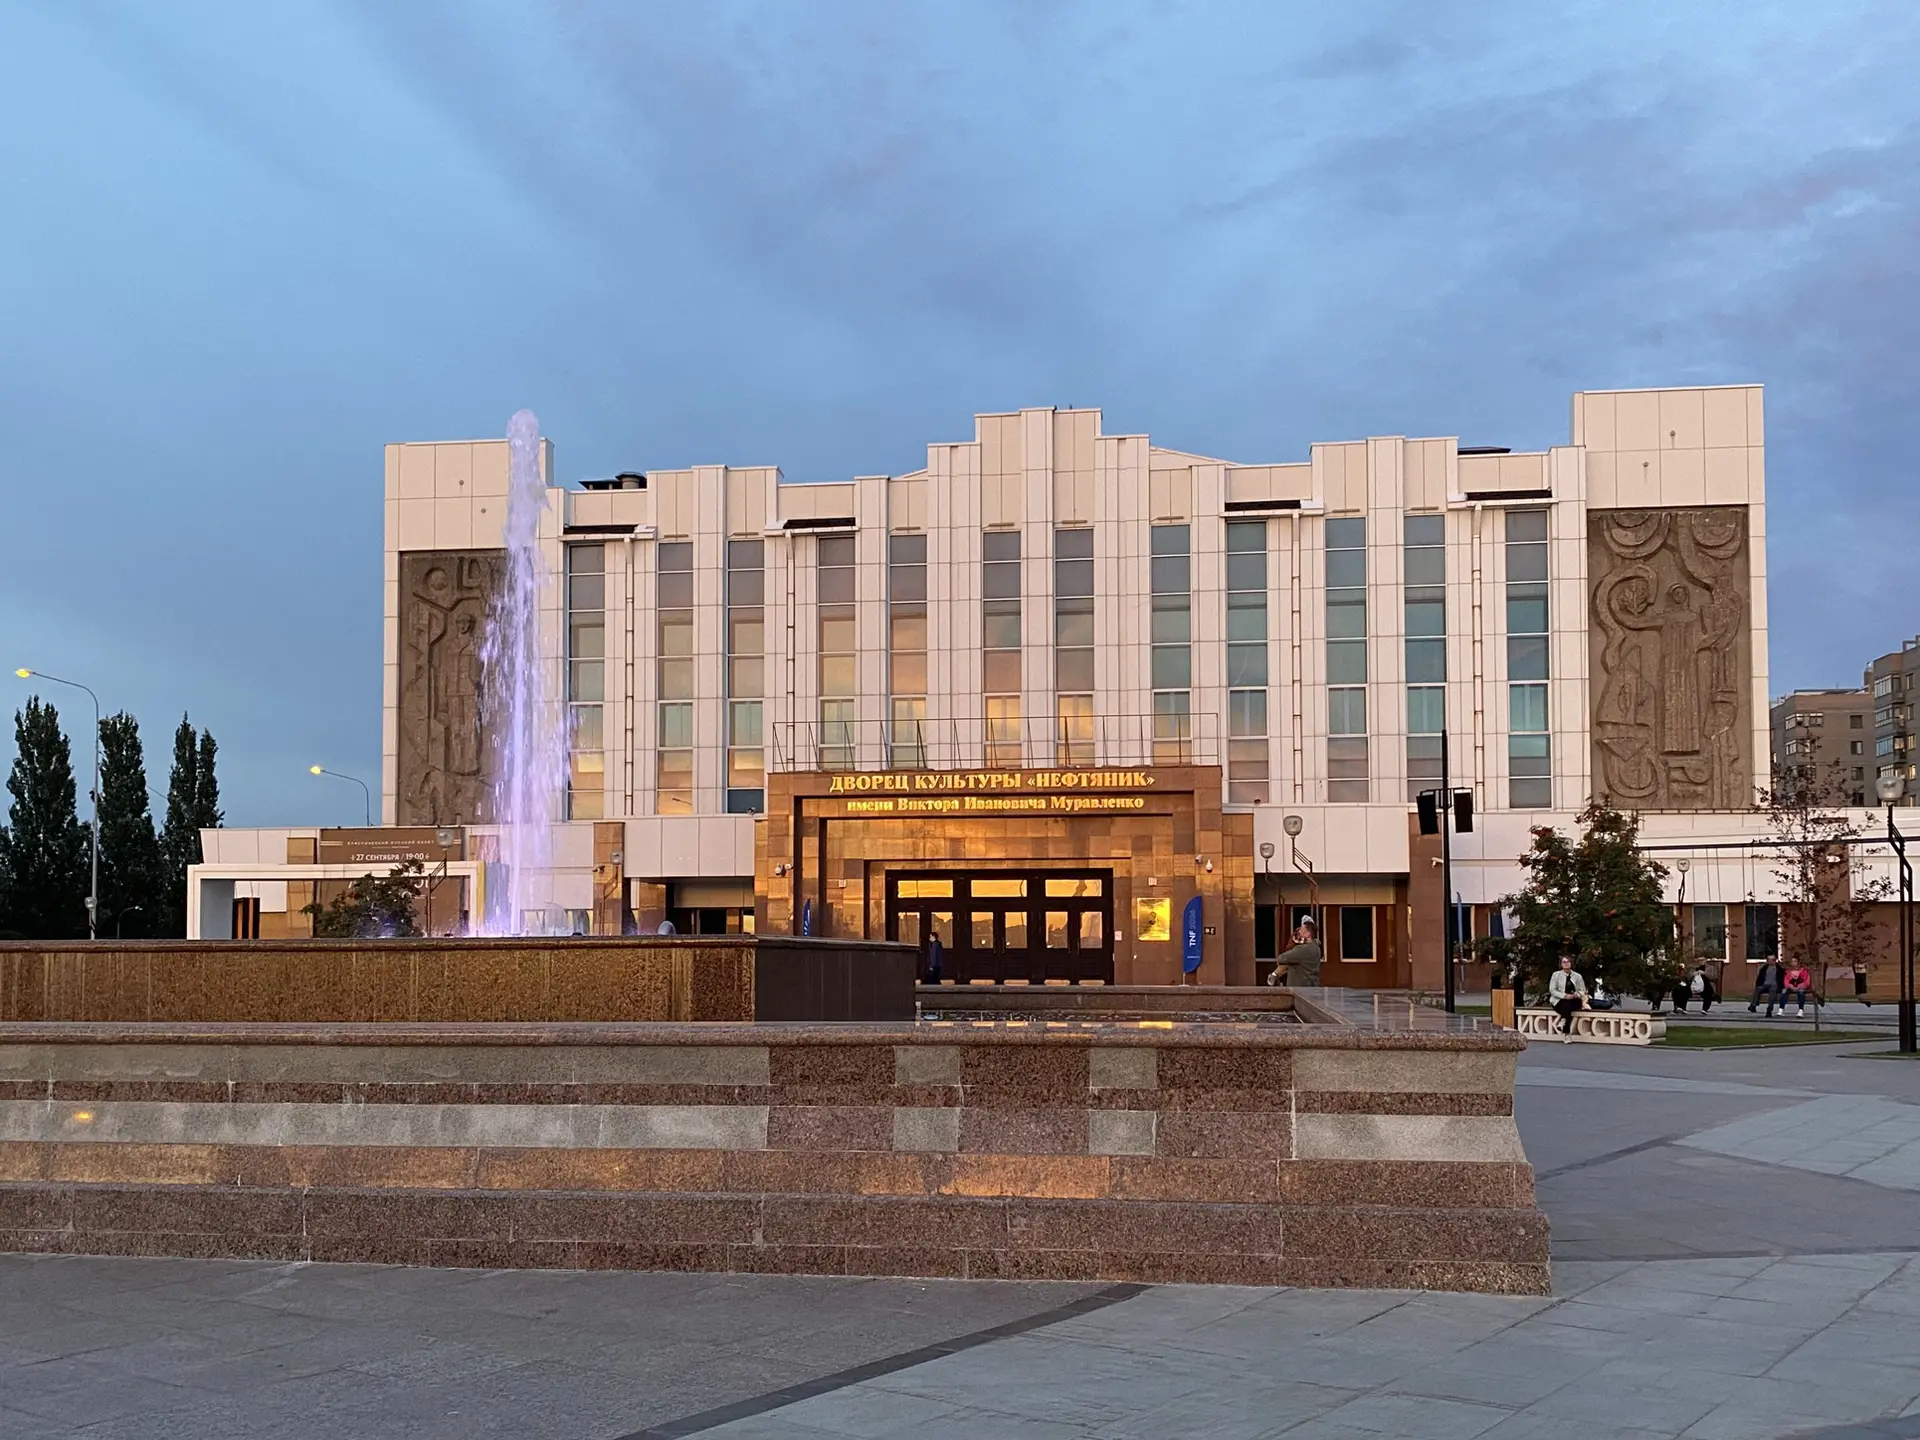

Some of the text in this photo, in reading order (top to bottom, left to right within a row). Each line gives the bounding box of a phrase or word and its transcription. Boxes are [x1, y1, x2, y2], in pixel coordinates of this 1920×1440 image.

[829, 772, 1155, 793] ДВОРЕЦ КУЛЬТУРЫ «НЕФТЯНИК»
[847, 796, 1144, 812] имени Виктора Ивановича Муравленко
[356, 853, 365, 861] 27
[365, 853, 400, 861] СЕНТЯБРЯ
[1188, 930, 1197, 947] TNF
